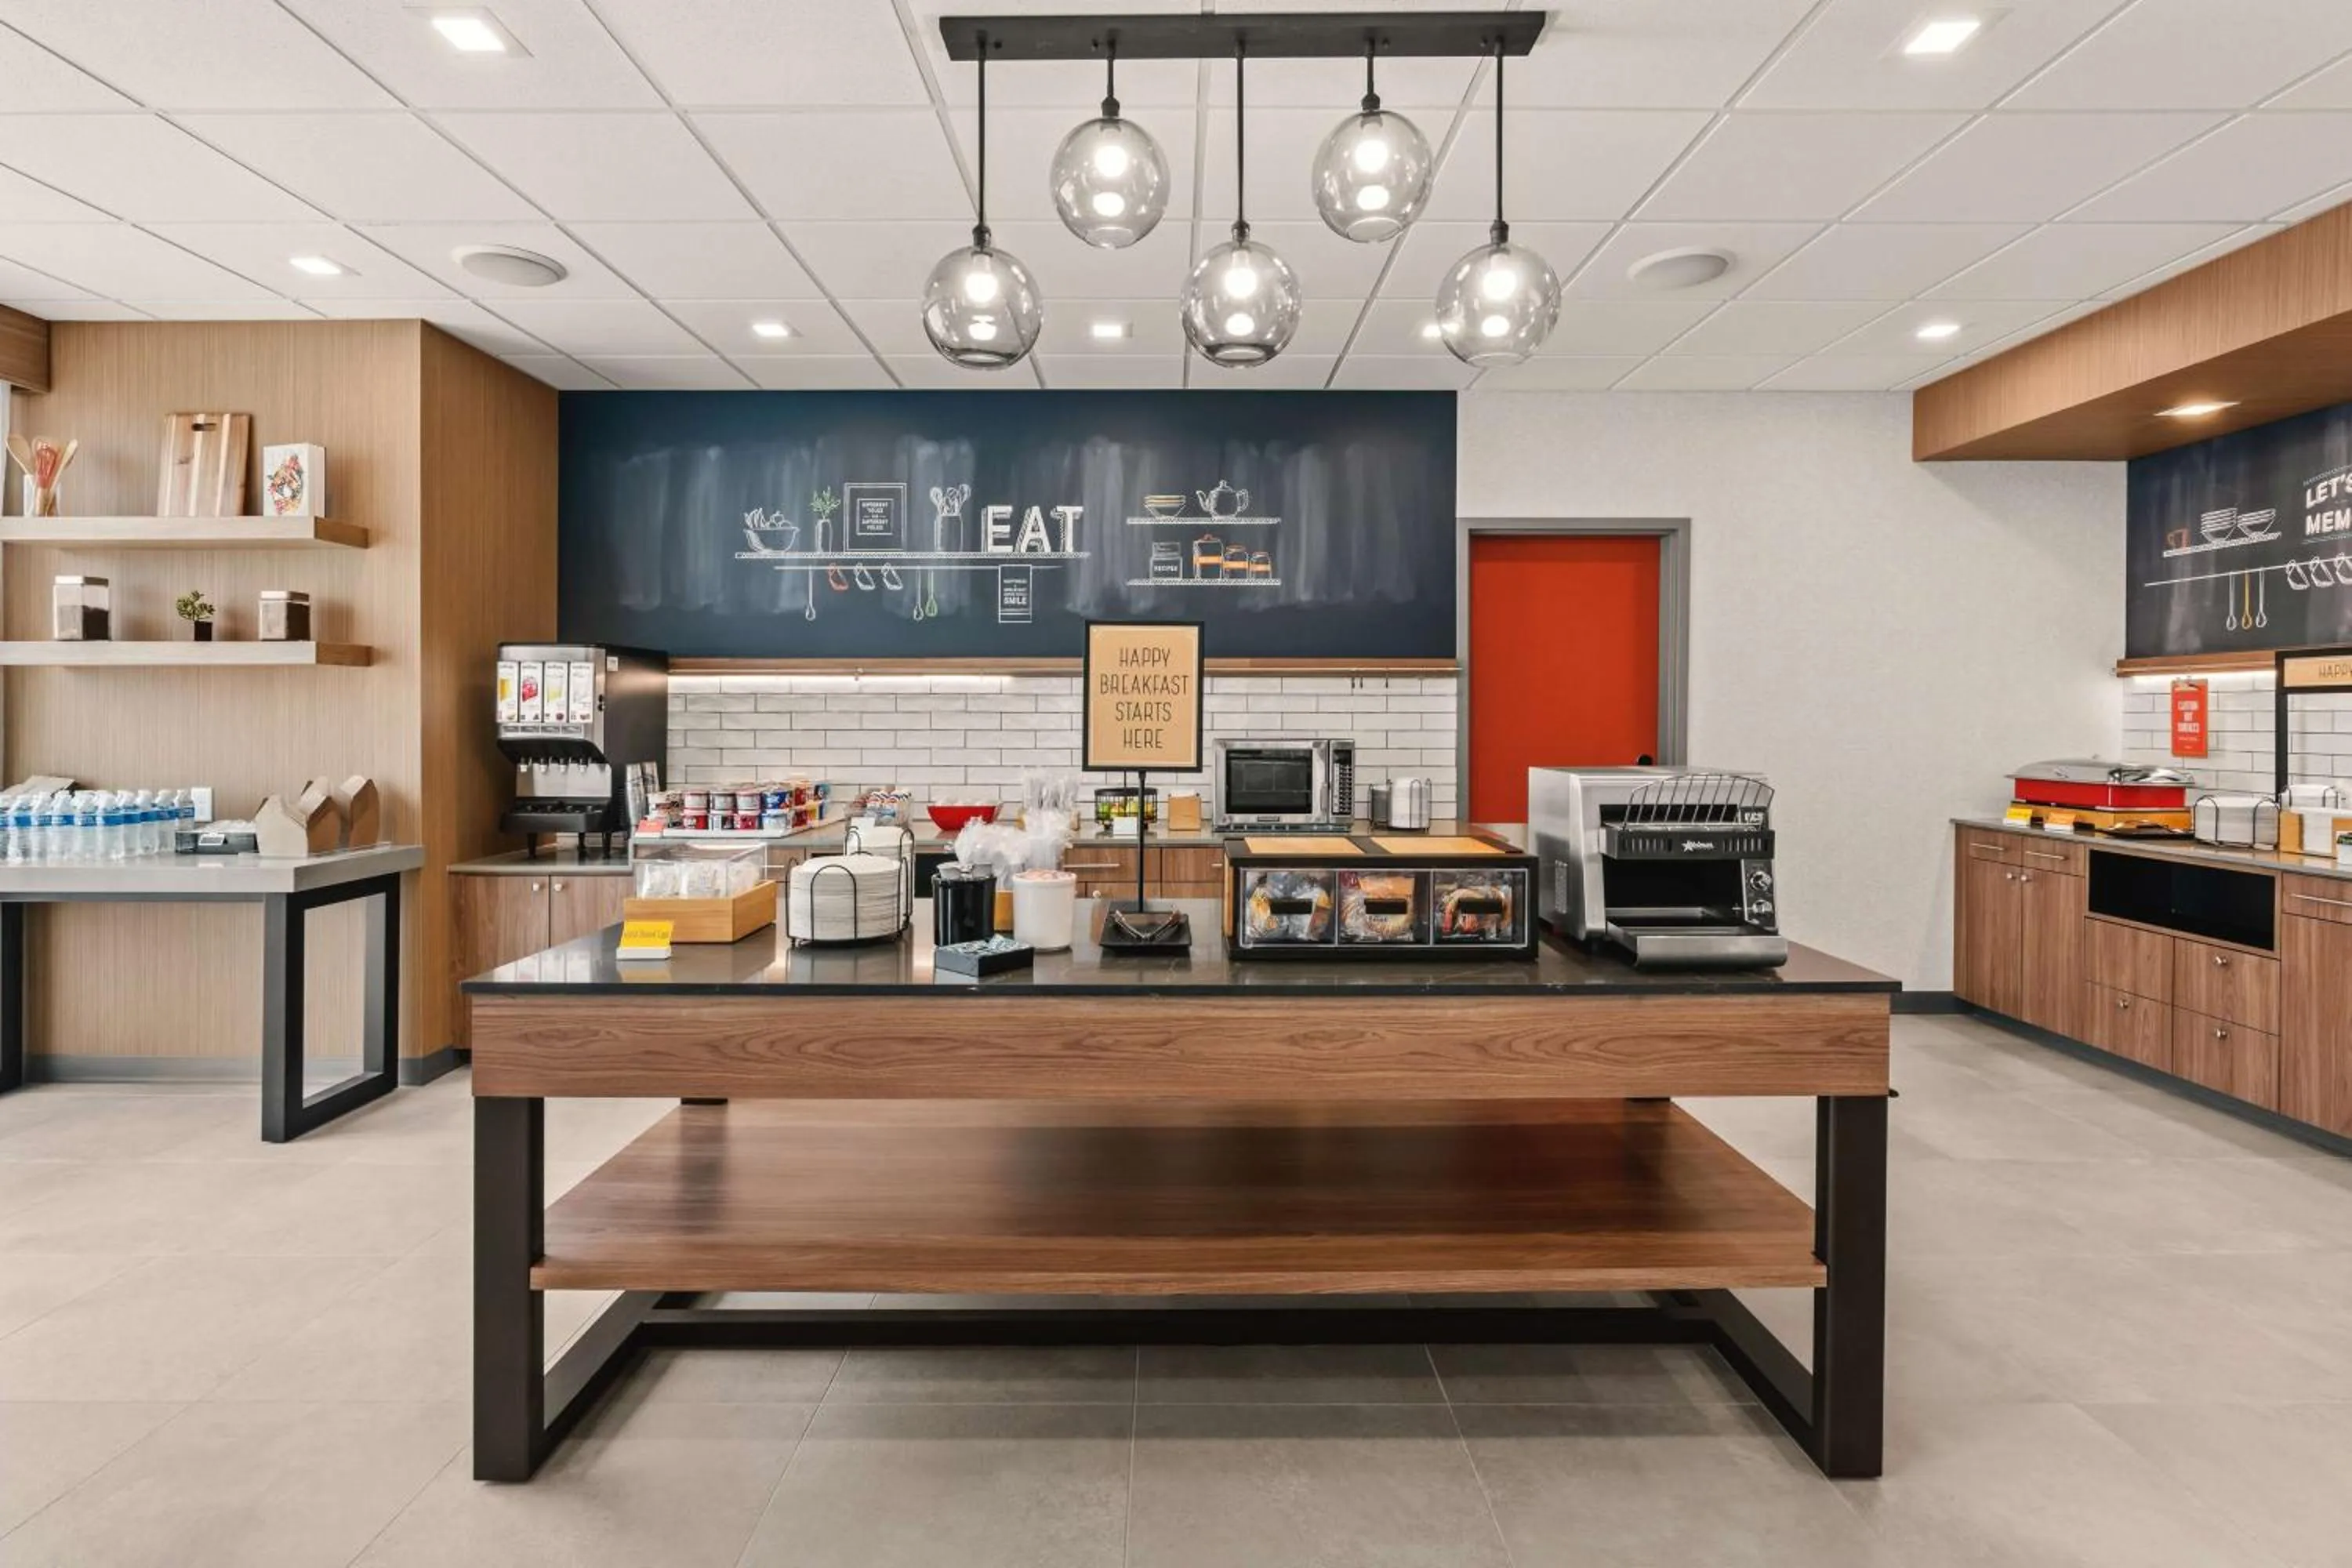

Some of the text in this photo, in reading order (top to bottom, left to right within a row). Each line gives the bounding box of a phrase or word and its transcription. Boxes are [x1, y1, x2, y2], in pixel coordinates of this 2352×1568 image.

[2306, 474, 2352, 509] LET'S
[981, 505, 1083, 552] EAT
[1119, 647, 1171, 668] HAPPY
[2318, 663, 2352, 679] HAPP
[1099, 673, 1189, 695] BREAKFAST
[1115, 702, 1173, 722] STARTS
[1123, 728, 1164, 749] HERE
